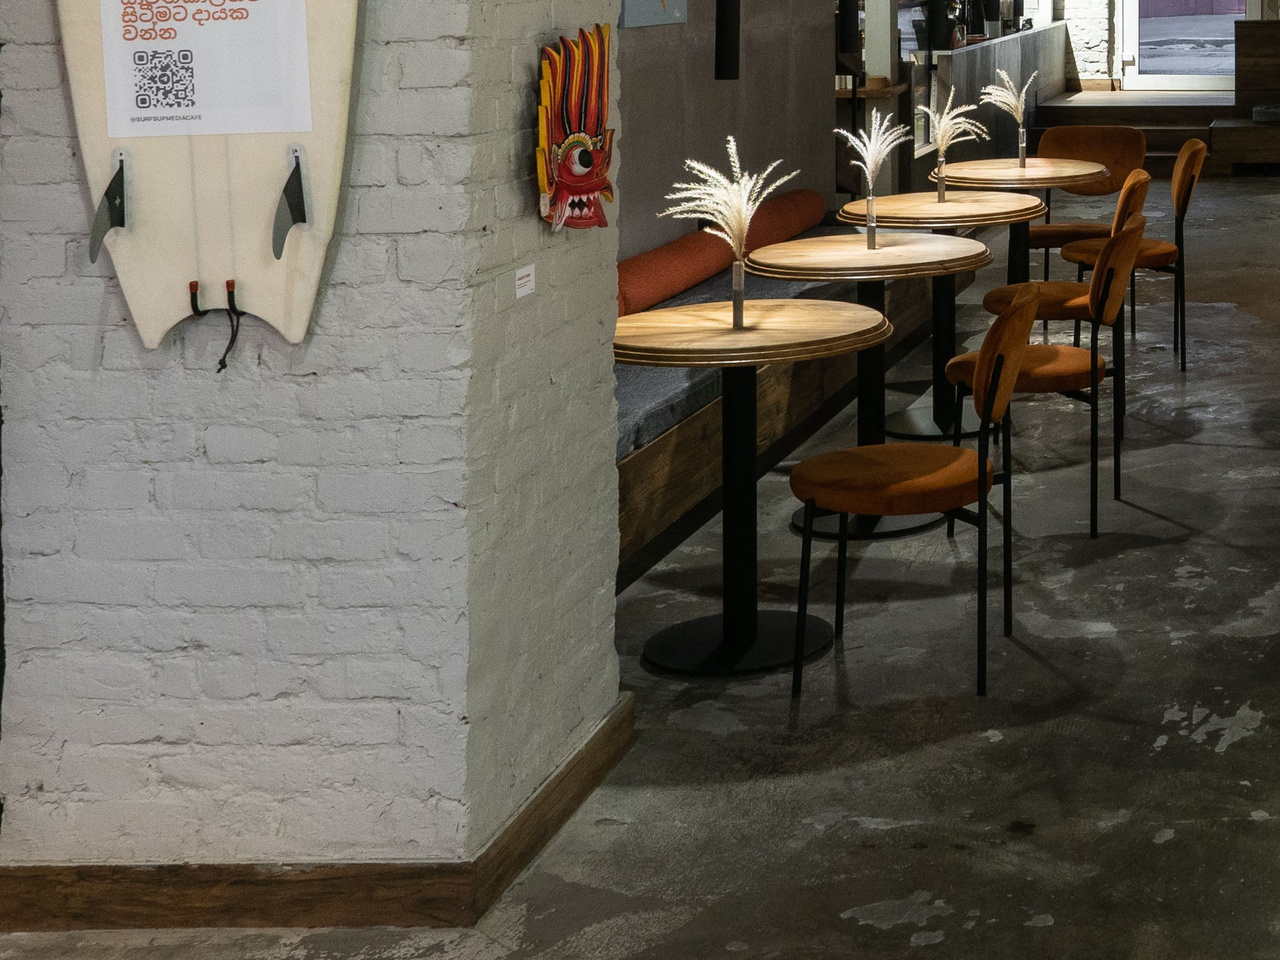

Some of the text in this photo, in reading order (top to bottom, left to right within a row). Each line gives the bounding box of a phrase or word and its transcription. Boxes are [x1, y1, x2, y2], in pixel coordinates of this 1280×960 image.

[121, 3, 249, 26] සිටීමට දායක
[122, 21, 177, 41] වන්න
